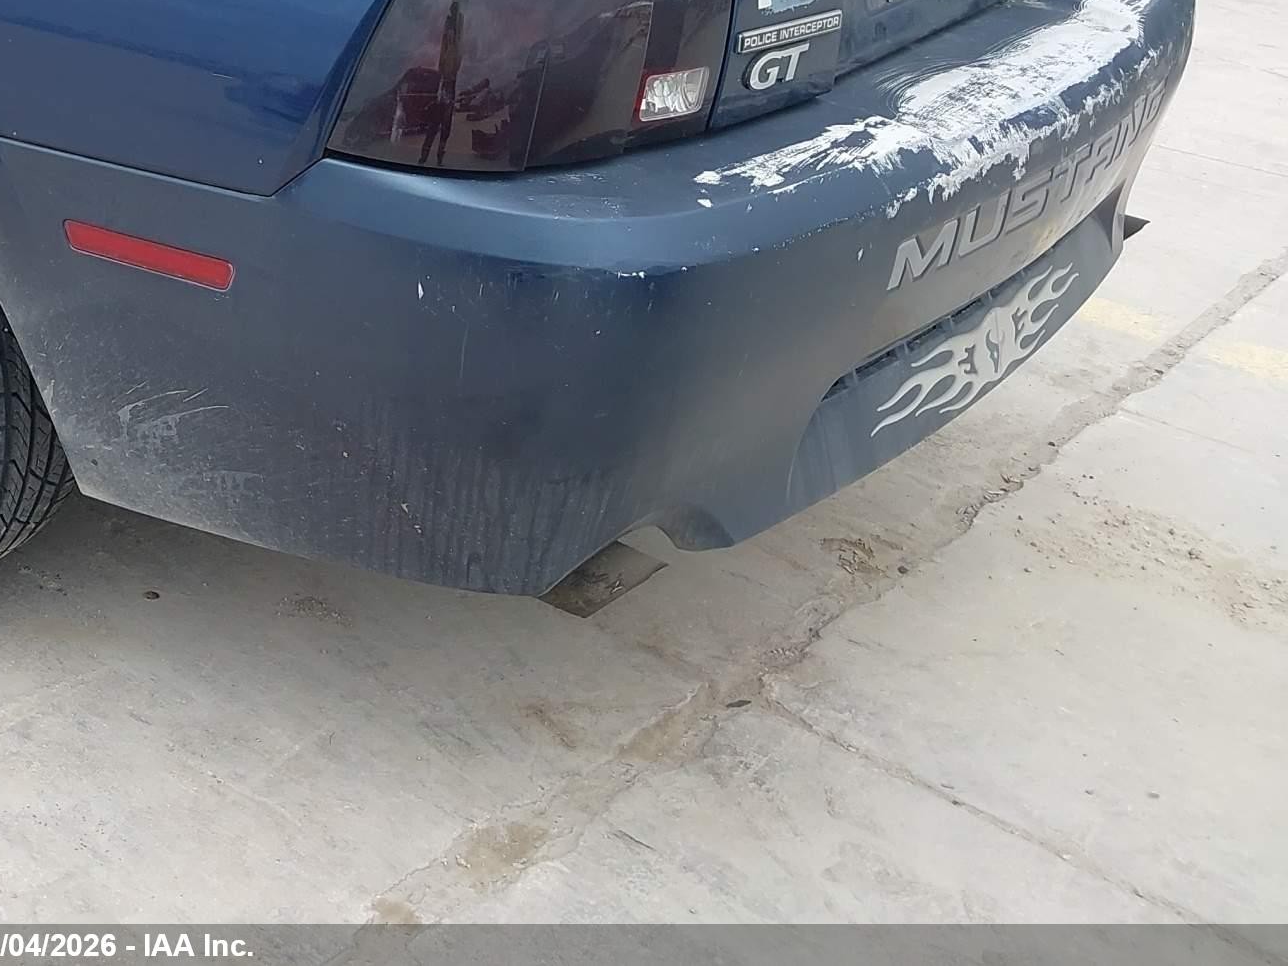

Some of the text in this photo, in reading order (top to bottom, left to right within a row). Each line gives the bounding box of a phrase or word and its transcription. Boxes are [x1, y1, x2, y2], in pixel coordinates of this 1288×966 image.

[743, 16, 840, 49] POLICE INTERCEPTOR
[749, 42, 810, 91] GT
[886, 83, 1169, 292] MUSTANG
